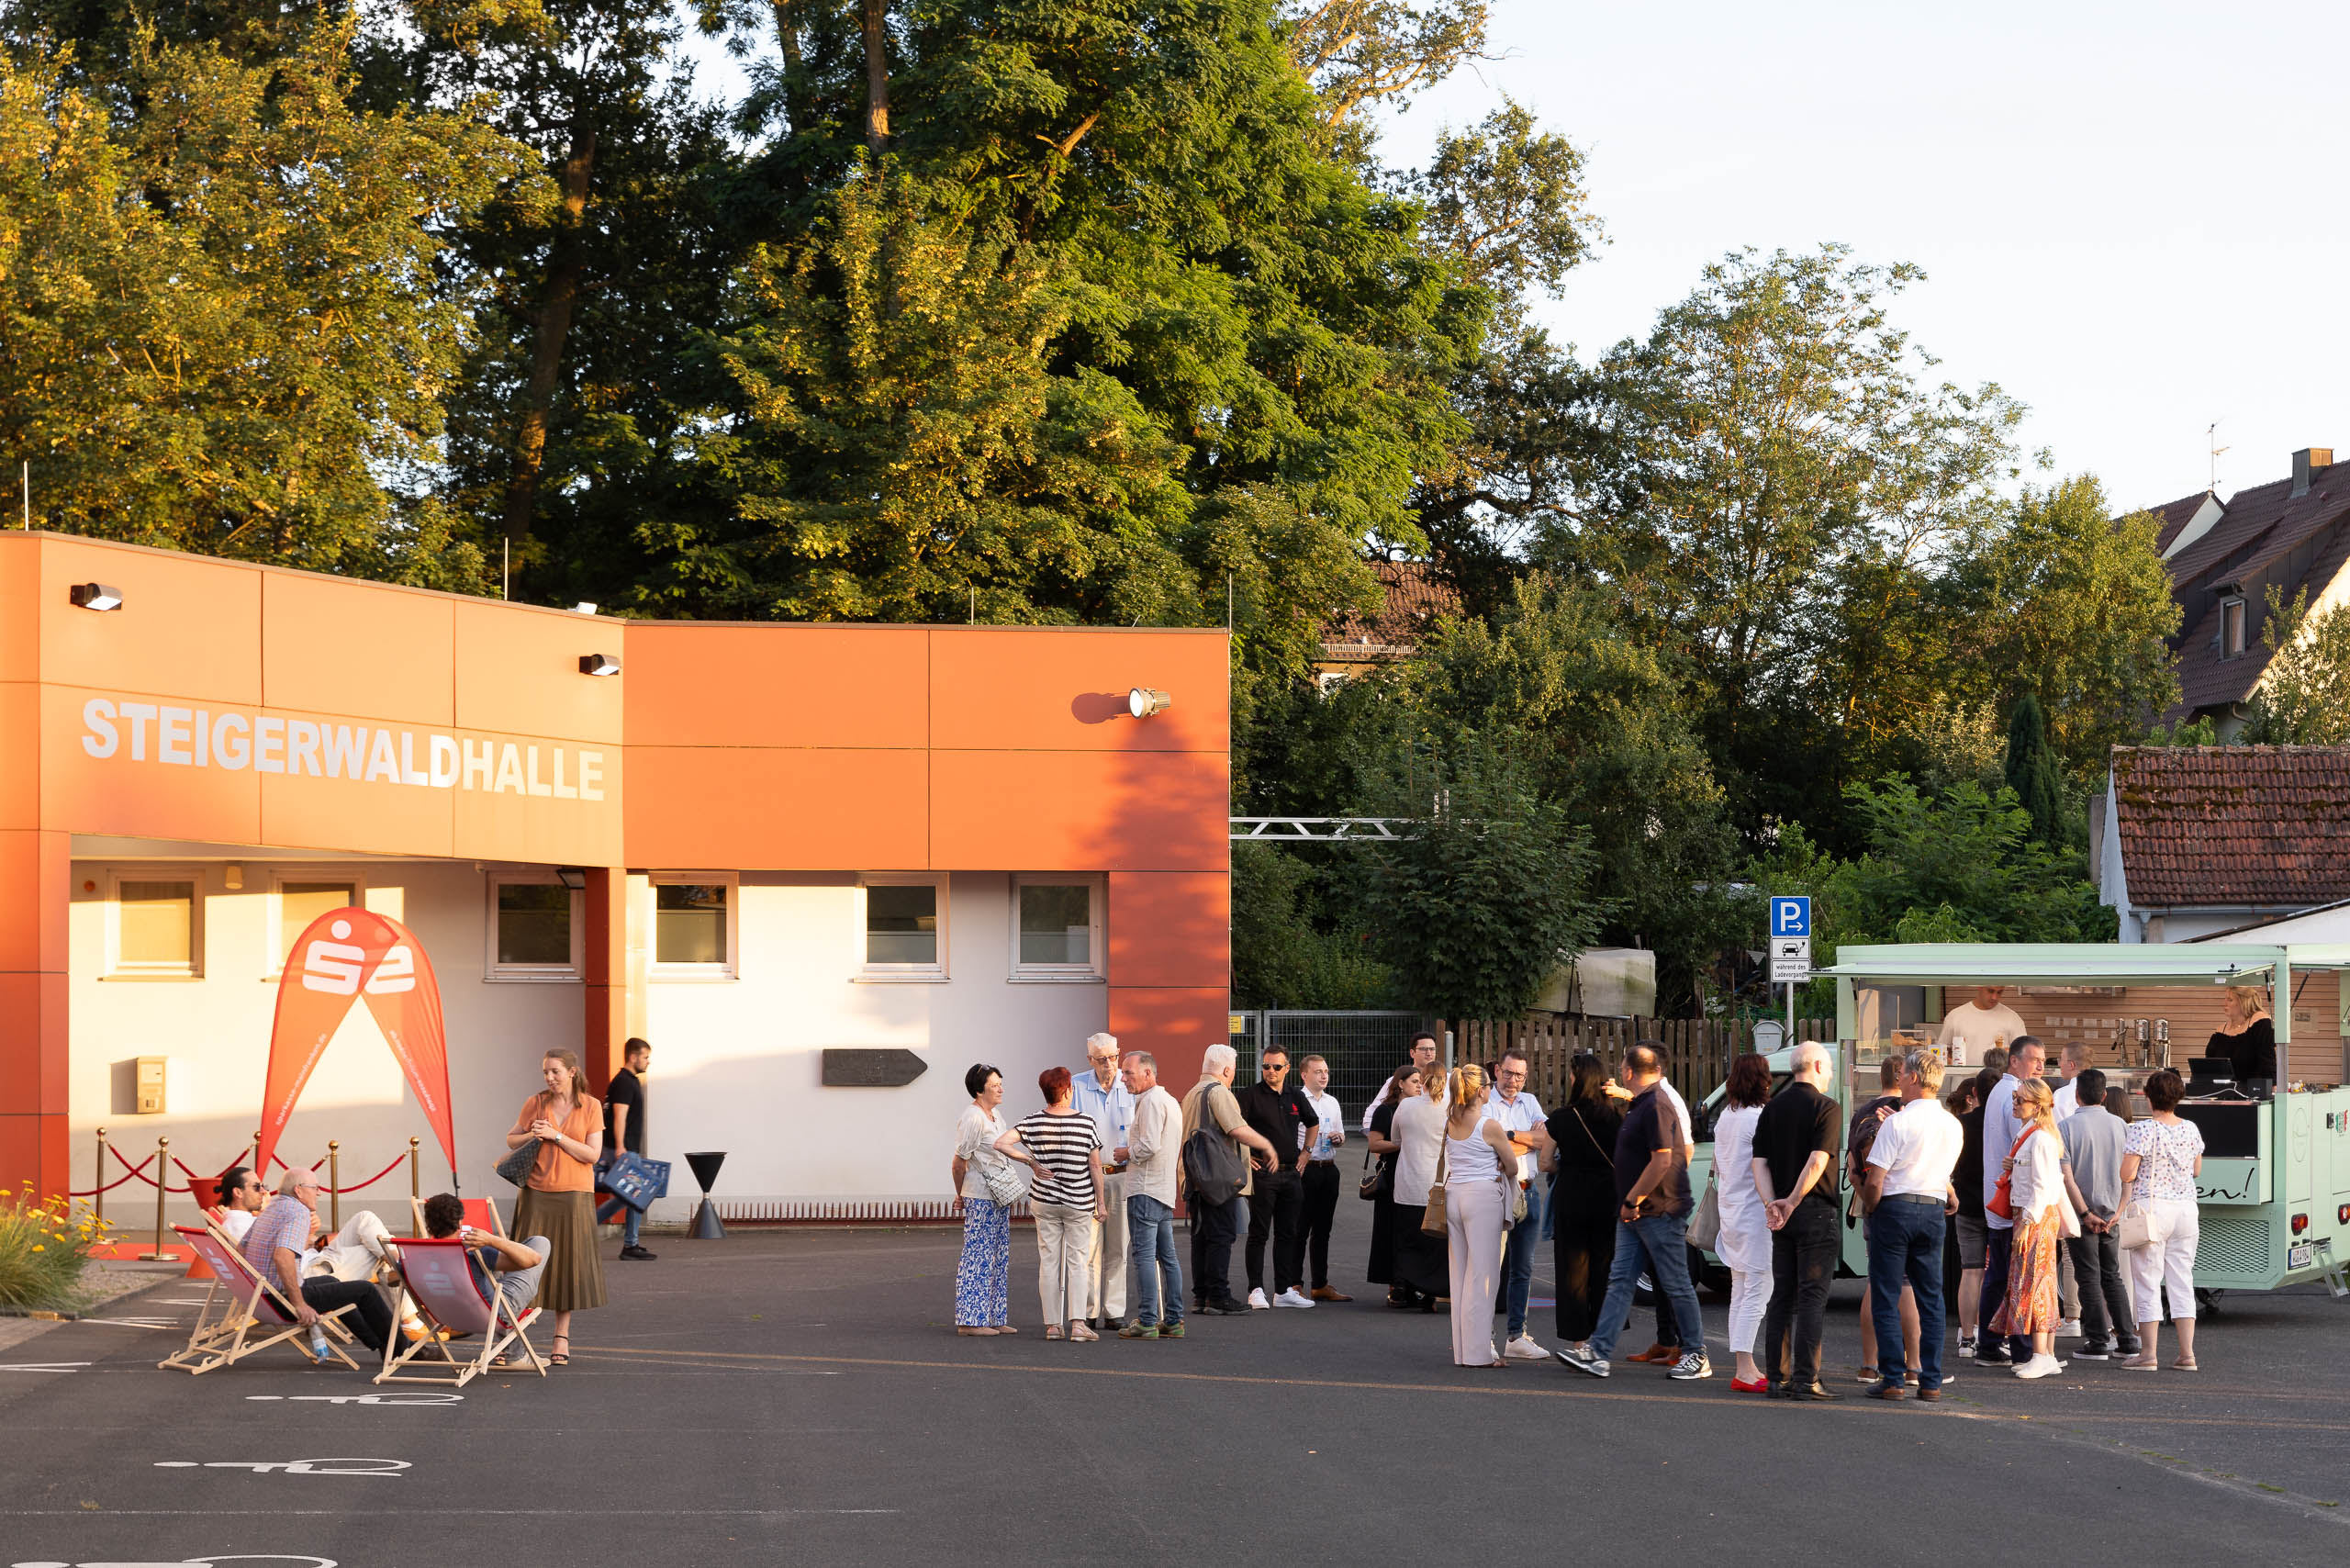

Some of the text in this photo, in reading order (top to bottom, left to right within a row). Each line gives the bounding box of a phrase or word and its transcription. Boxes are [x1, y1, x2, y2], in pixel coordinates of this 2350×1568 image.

[81, 698, 605, 802] STEIGERWALDHALLE
[1780, 902, 1801, 932] P
[275, 1033, 327, 1126] sparkasse-mainfranken.de
